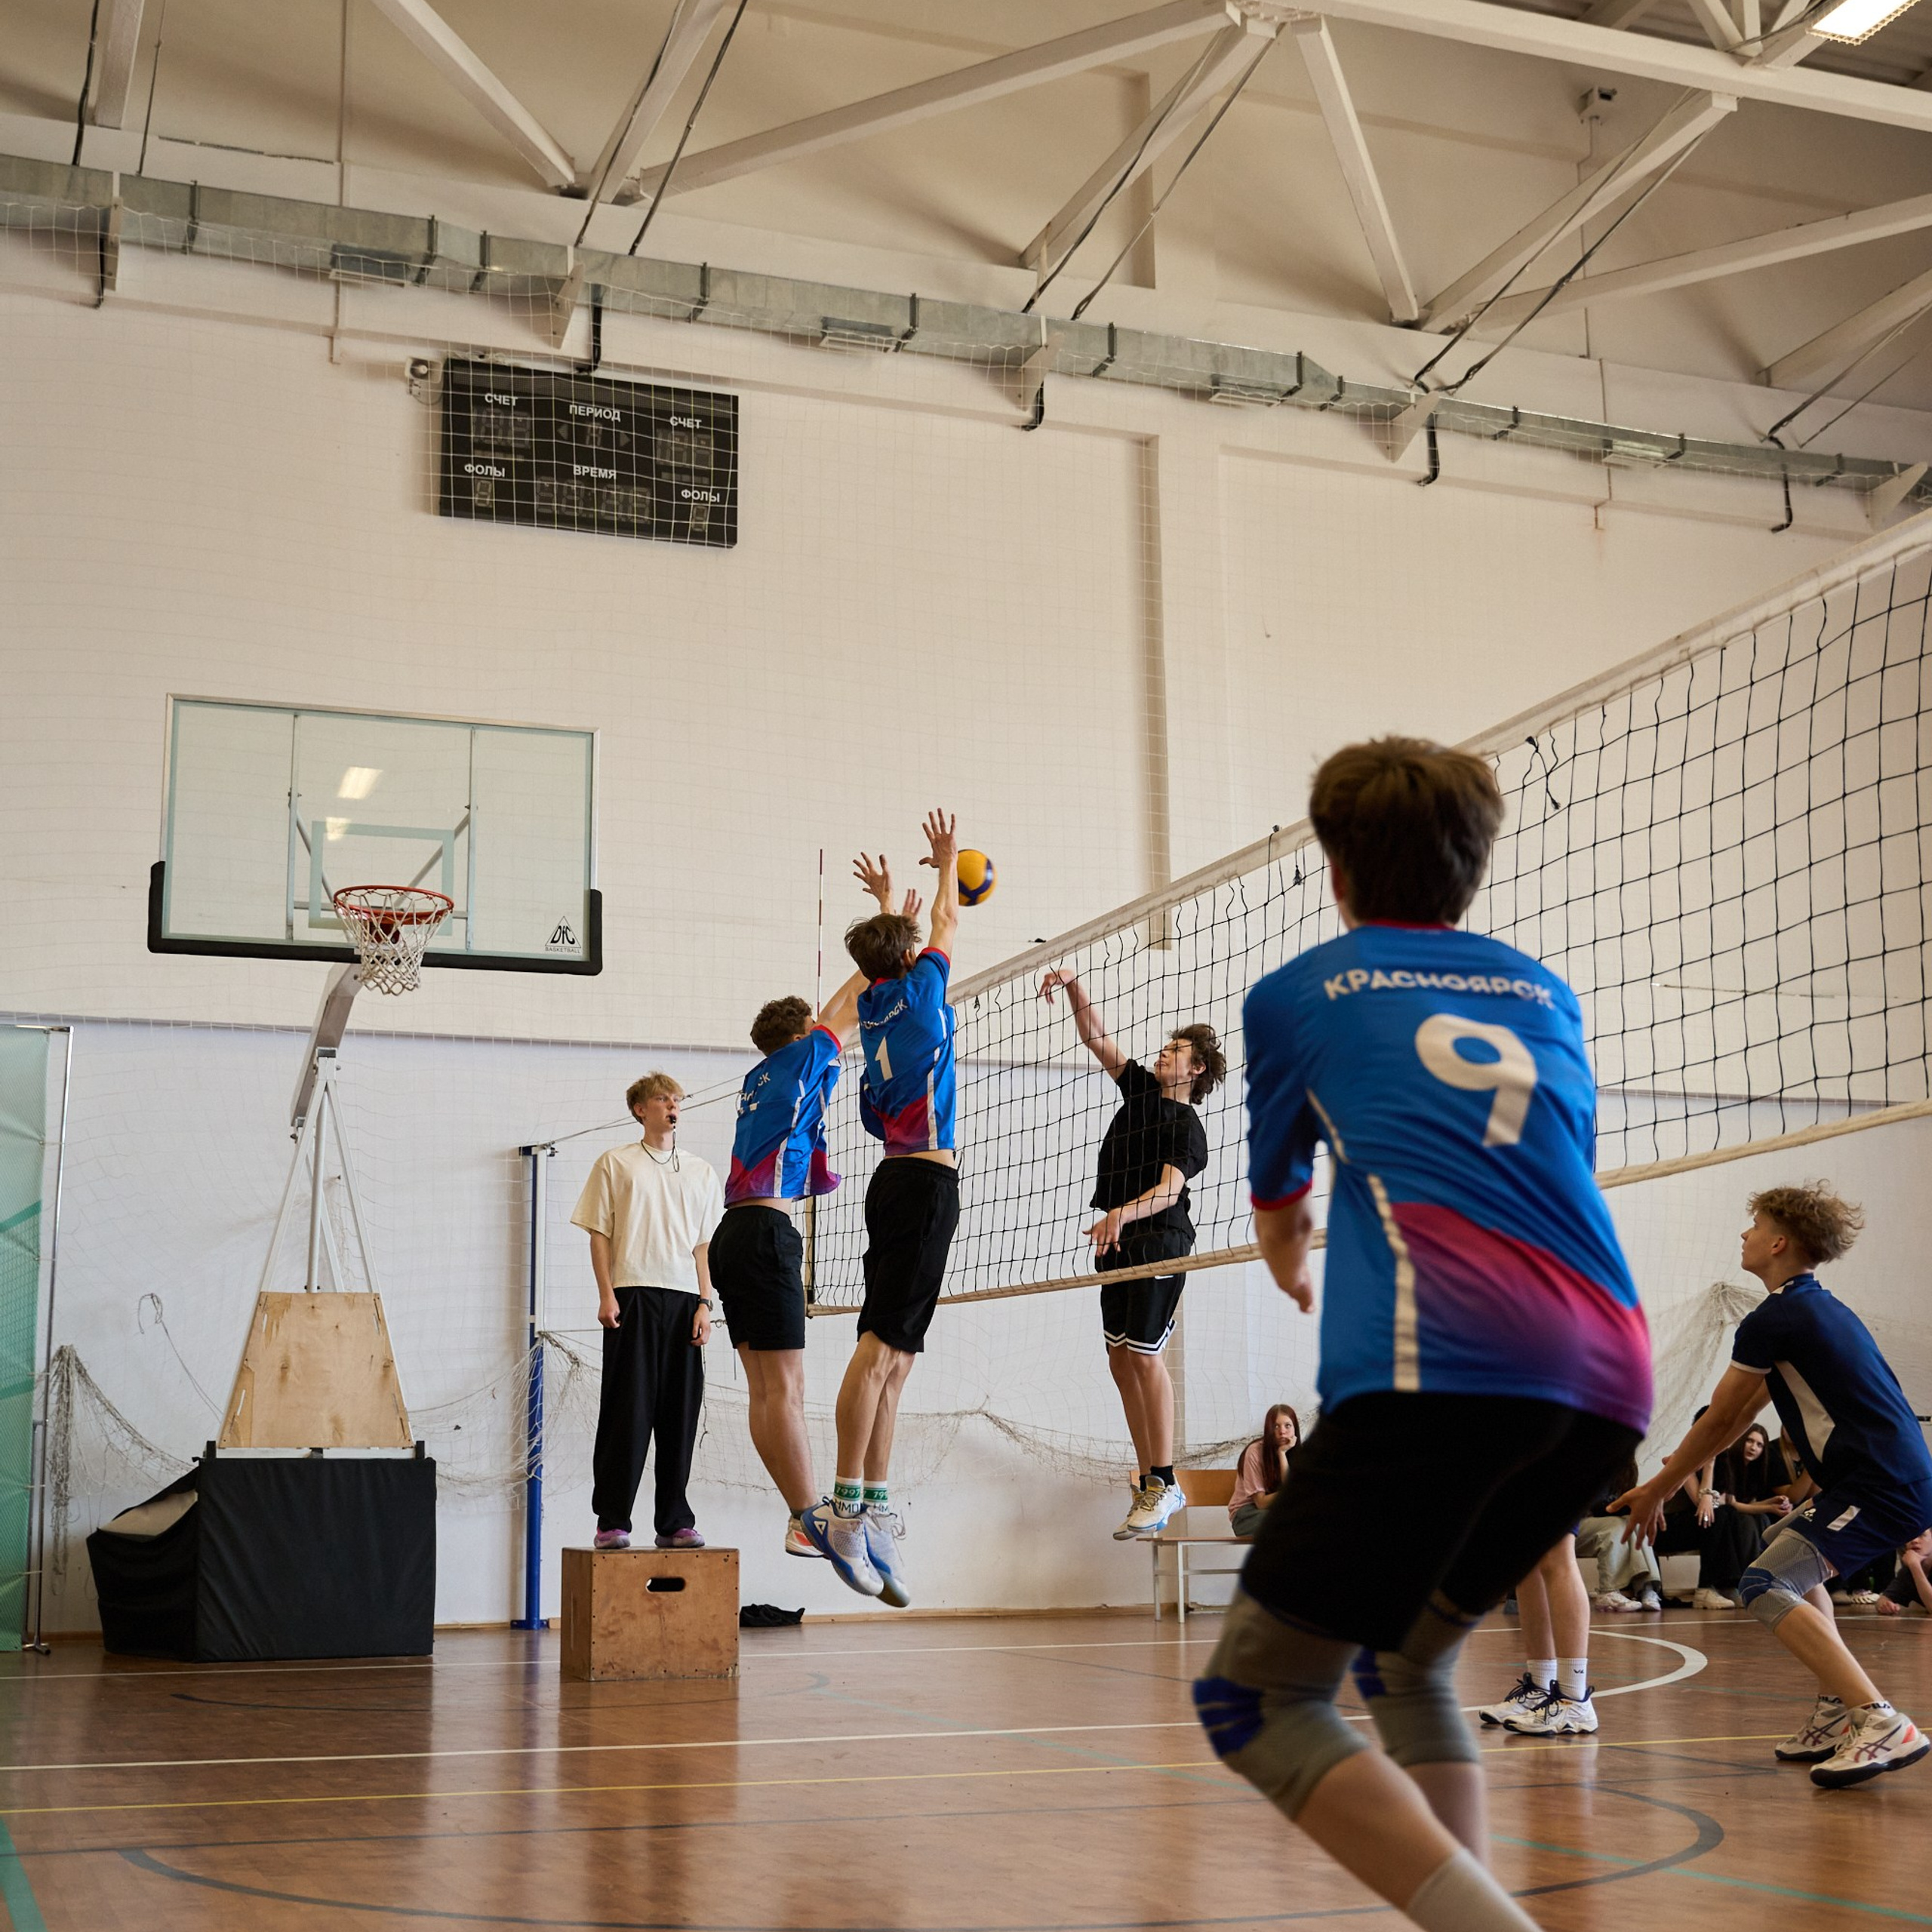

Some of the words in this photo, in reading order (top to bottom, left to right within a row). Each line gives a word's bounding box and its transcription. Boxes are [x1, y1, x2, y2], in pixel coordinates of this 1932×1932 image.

[485, 393, 518, 407] СЧЕТ
[569, 405, 620, 422] ПЕРИОД
[669, 416, 702, 429] СЧЕТ
[464, 463, 506, 478] ФОЛЫ
[573, 465, 617, 480] ВРЕМЯ
[681, 489, 720, 503] ФОЛЫ
[1324, 969, 1555, 1009] КРАСНОЯРСК
[875, 1036, 893, 1081] 1
[1416, 1014, 1537, 1147] 9
